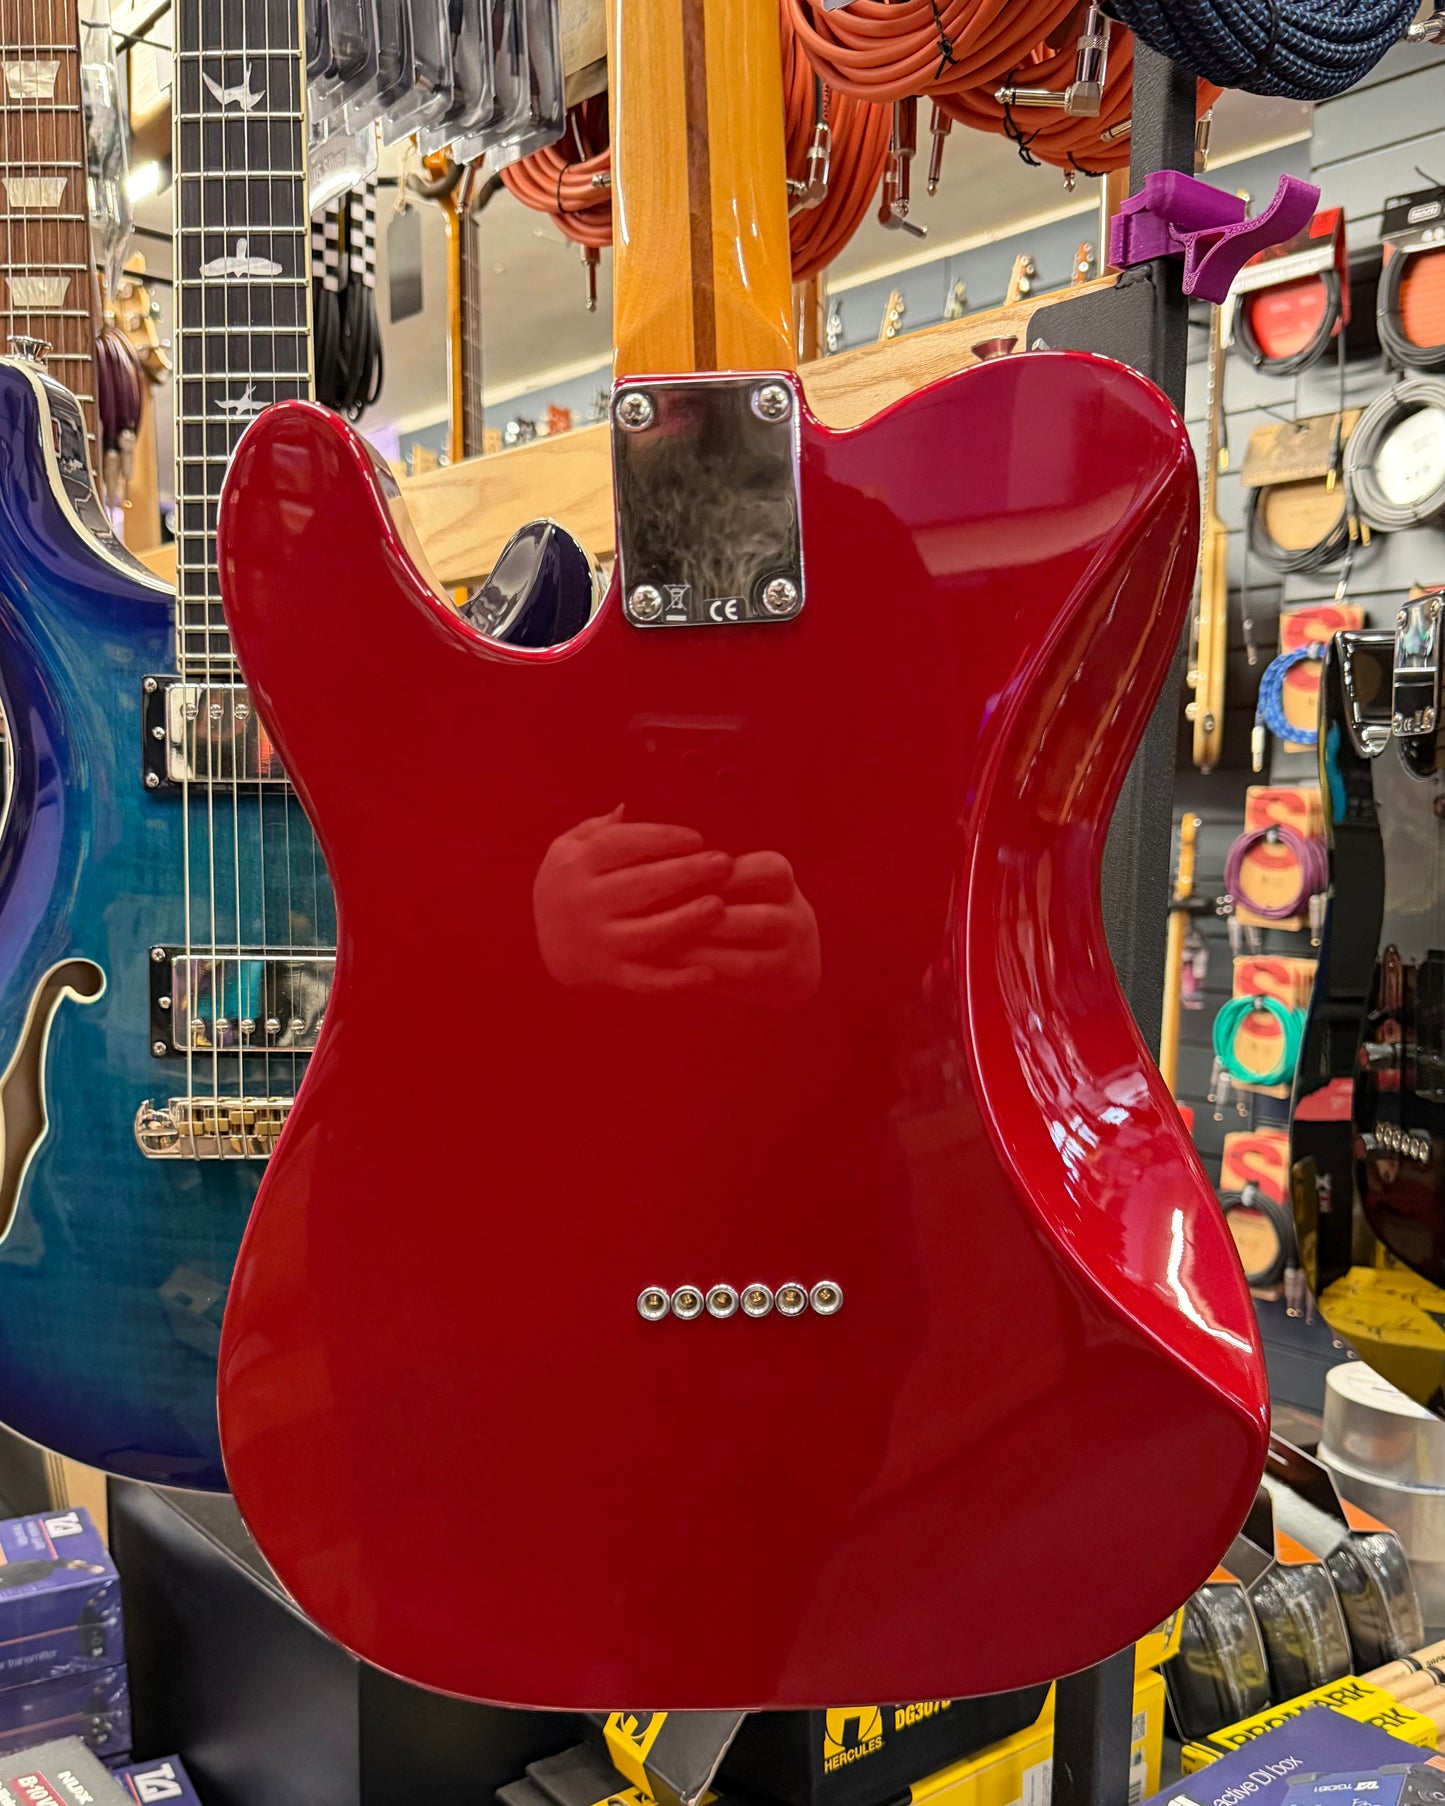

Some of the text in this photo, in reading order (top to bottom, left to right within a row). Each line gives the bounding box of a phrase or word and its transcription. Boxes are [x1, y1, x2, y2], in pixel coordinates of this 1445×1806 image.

[823, 1735, 884, 1775] HERCULES
[57, 1770, 94, 1805] NUX
[1213, 1781, 1260, 1806] active
[1248, 1768, 1277, 1786] DI
[1264, 1755, 1304, 1776] box
